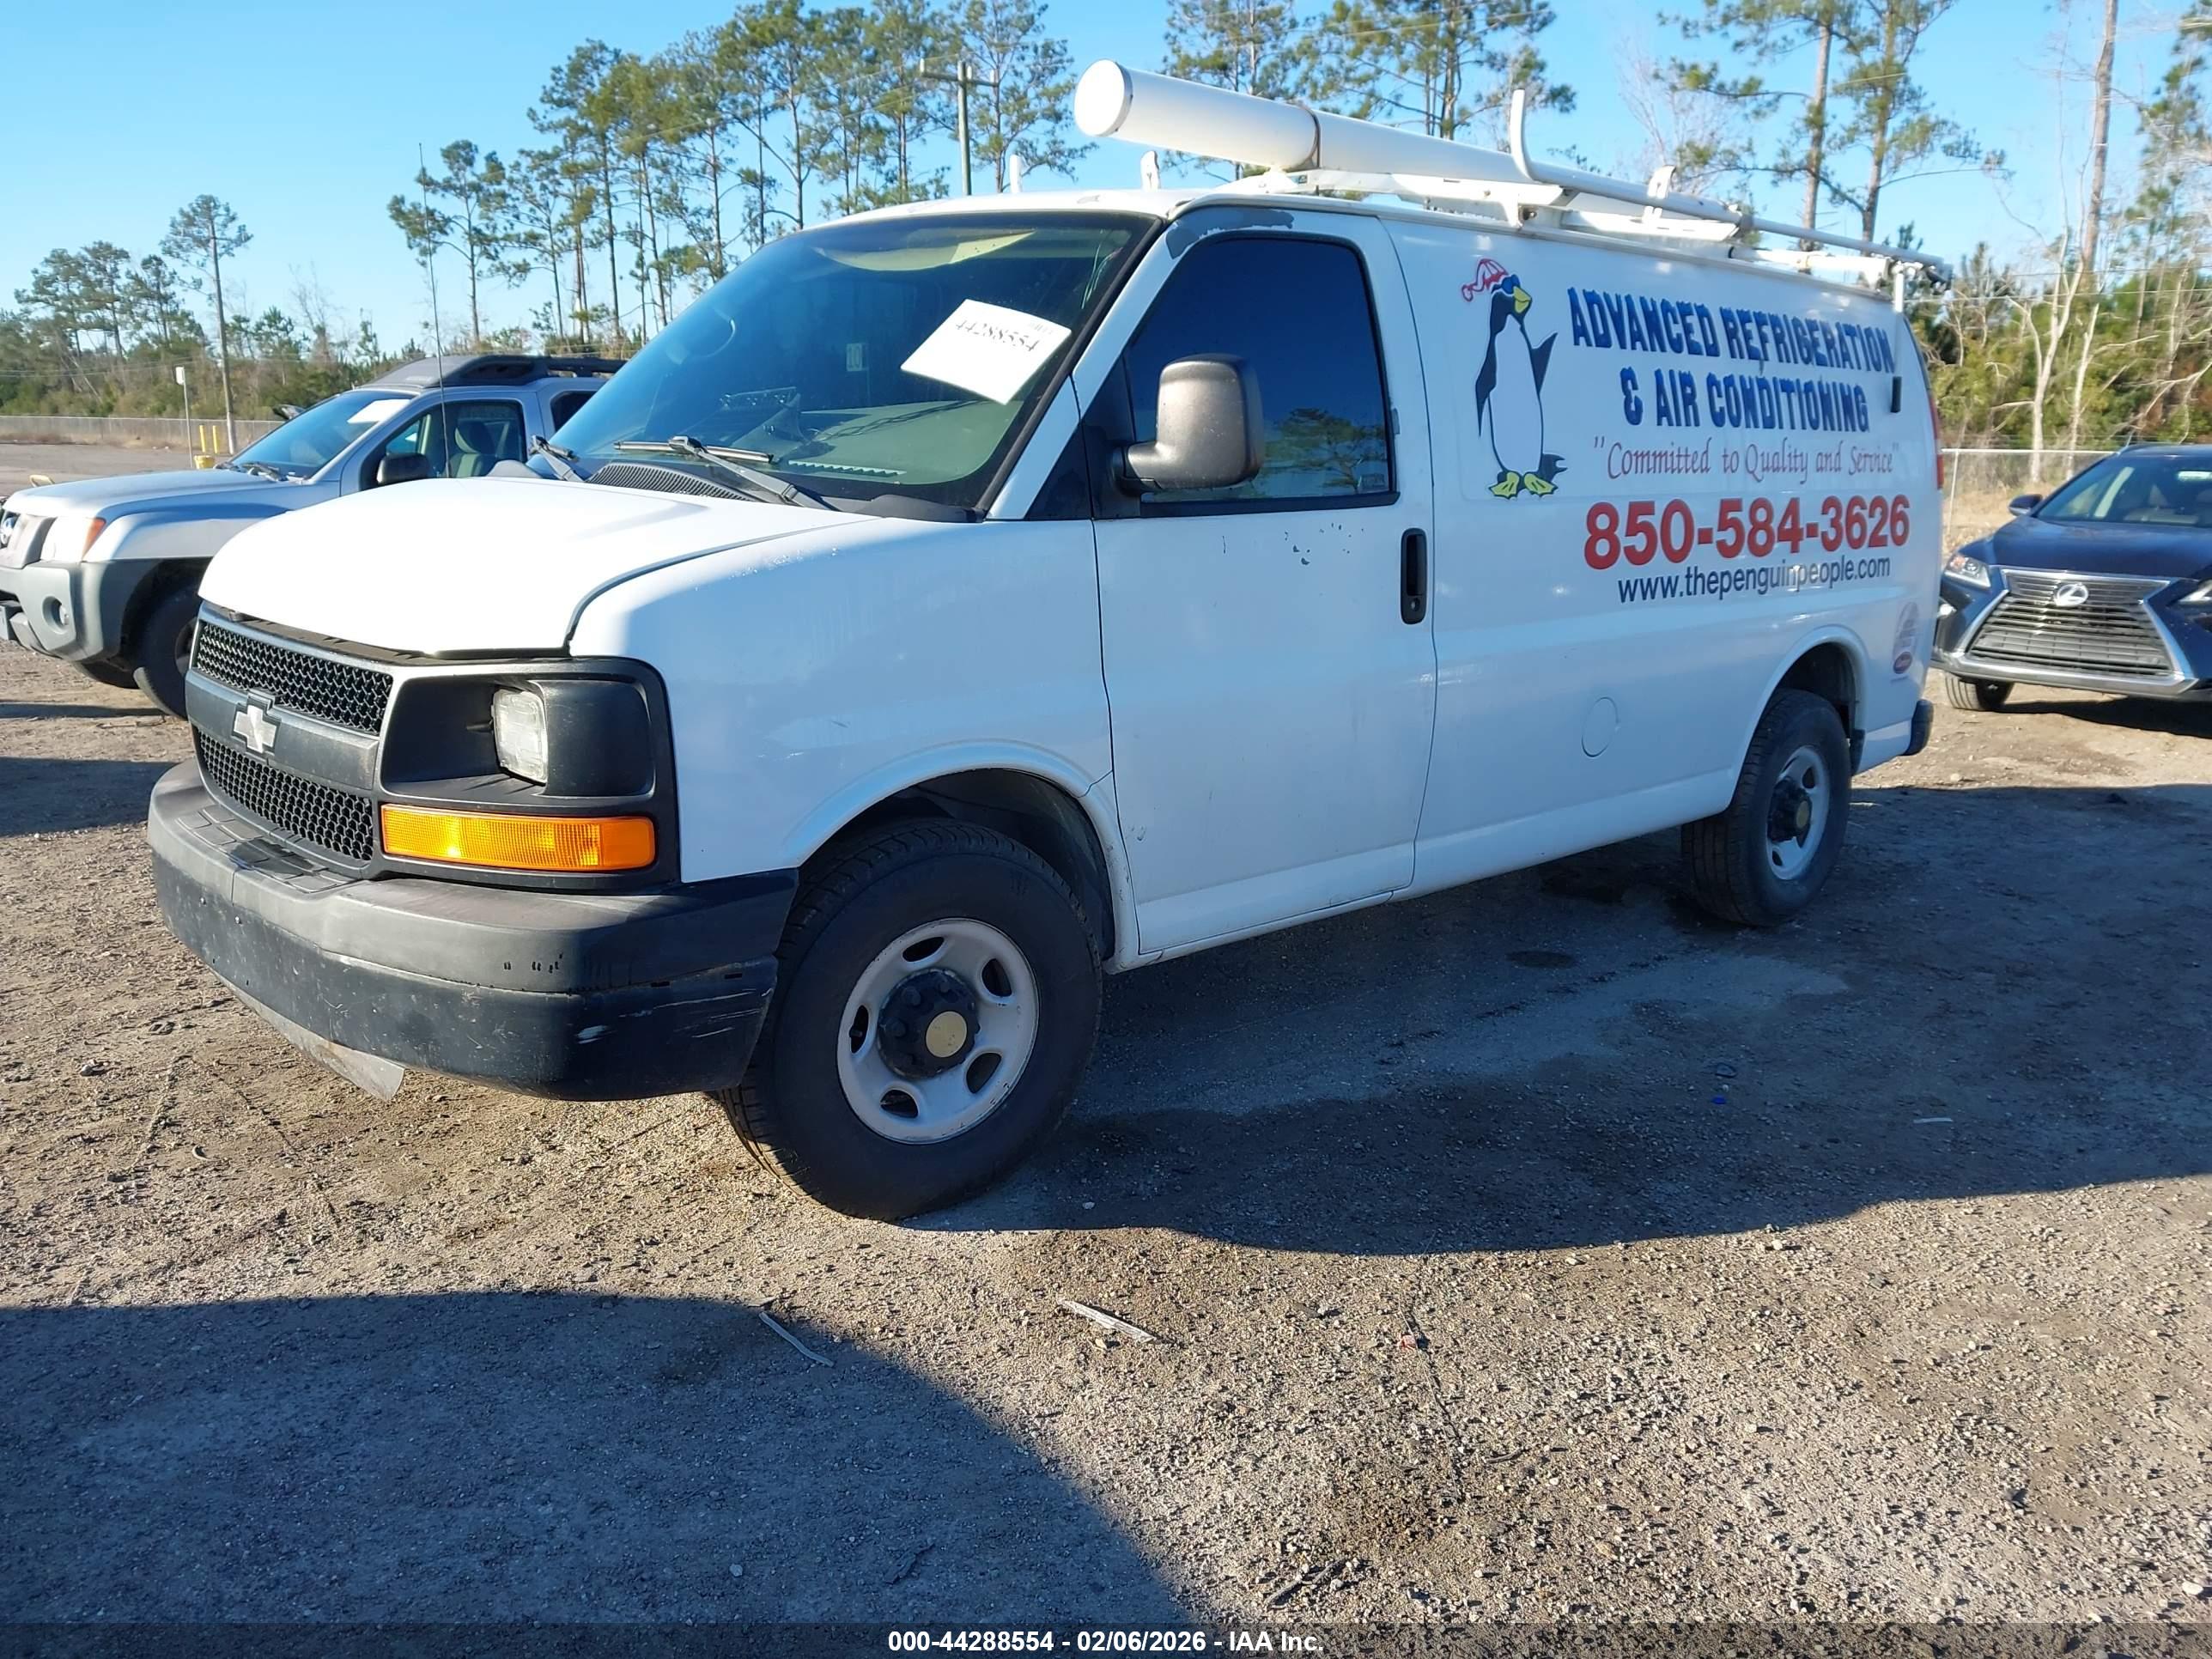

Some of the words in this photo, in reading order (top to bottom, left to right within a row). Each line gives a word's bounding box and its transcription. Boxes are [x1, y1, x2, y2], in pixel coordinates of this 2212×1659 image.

[1567, 287, 1720, 357] ADVANCED
[1719, 306, 1894, 374] REFRIGERATION
[1620, 366, 1644, 426] &
[1654, 368, 1700, 427] AIR
[1706, 373, 1870, 432] CONDITIONING
[1722, 447, 1739, 473] to
[1745, 437, 1808, 484] Quality
[1815, 441, 1844, 472] and
[1583, 494, 1910, 570] 850-584-3626
[1618, 556, 1891, 604] www.thepenguinpeople.com
